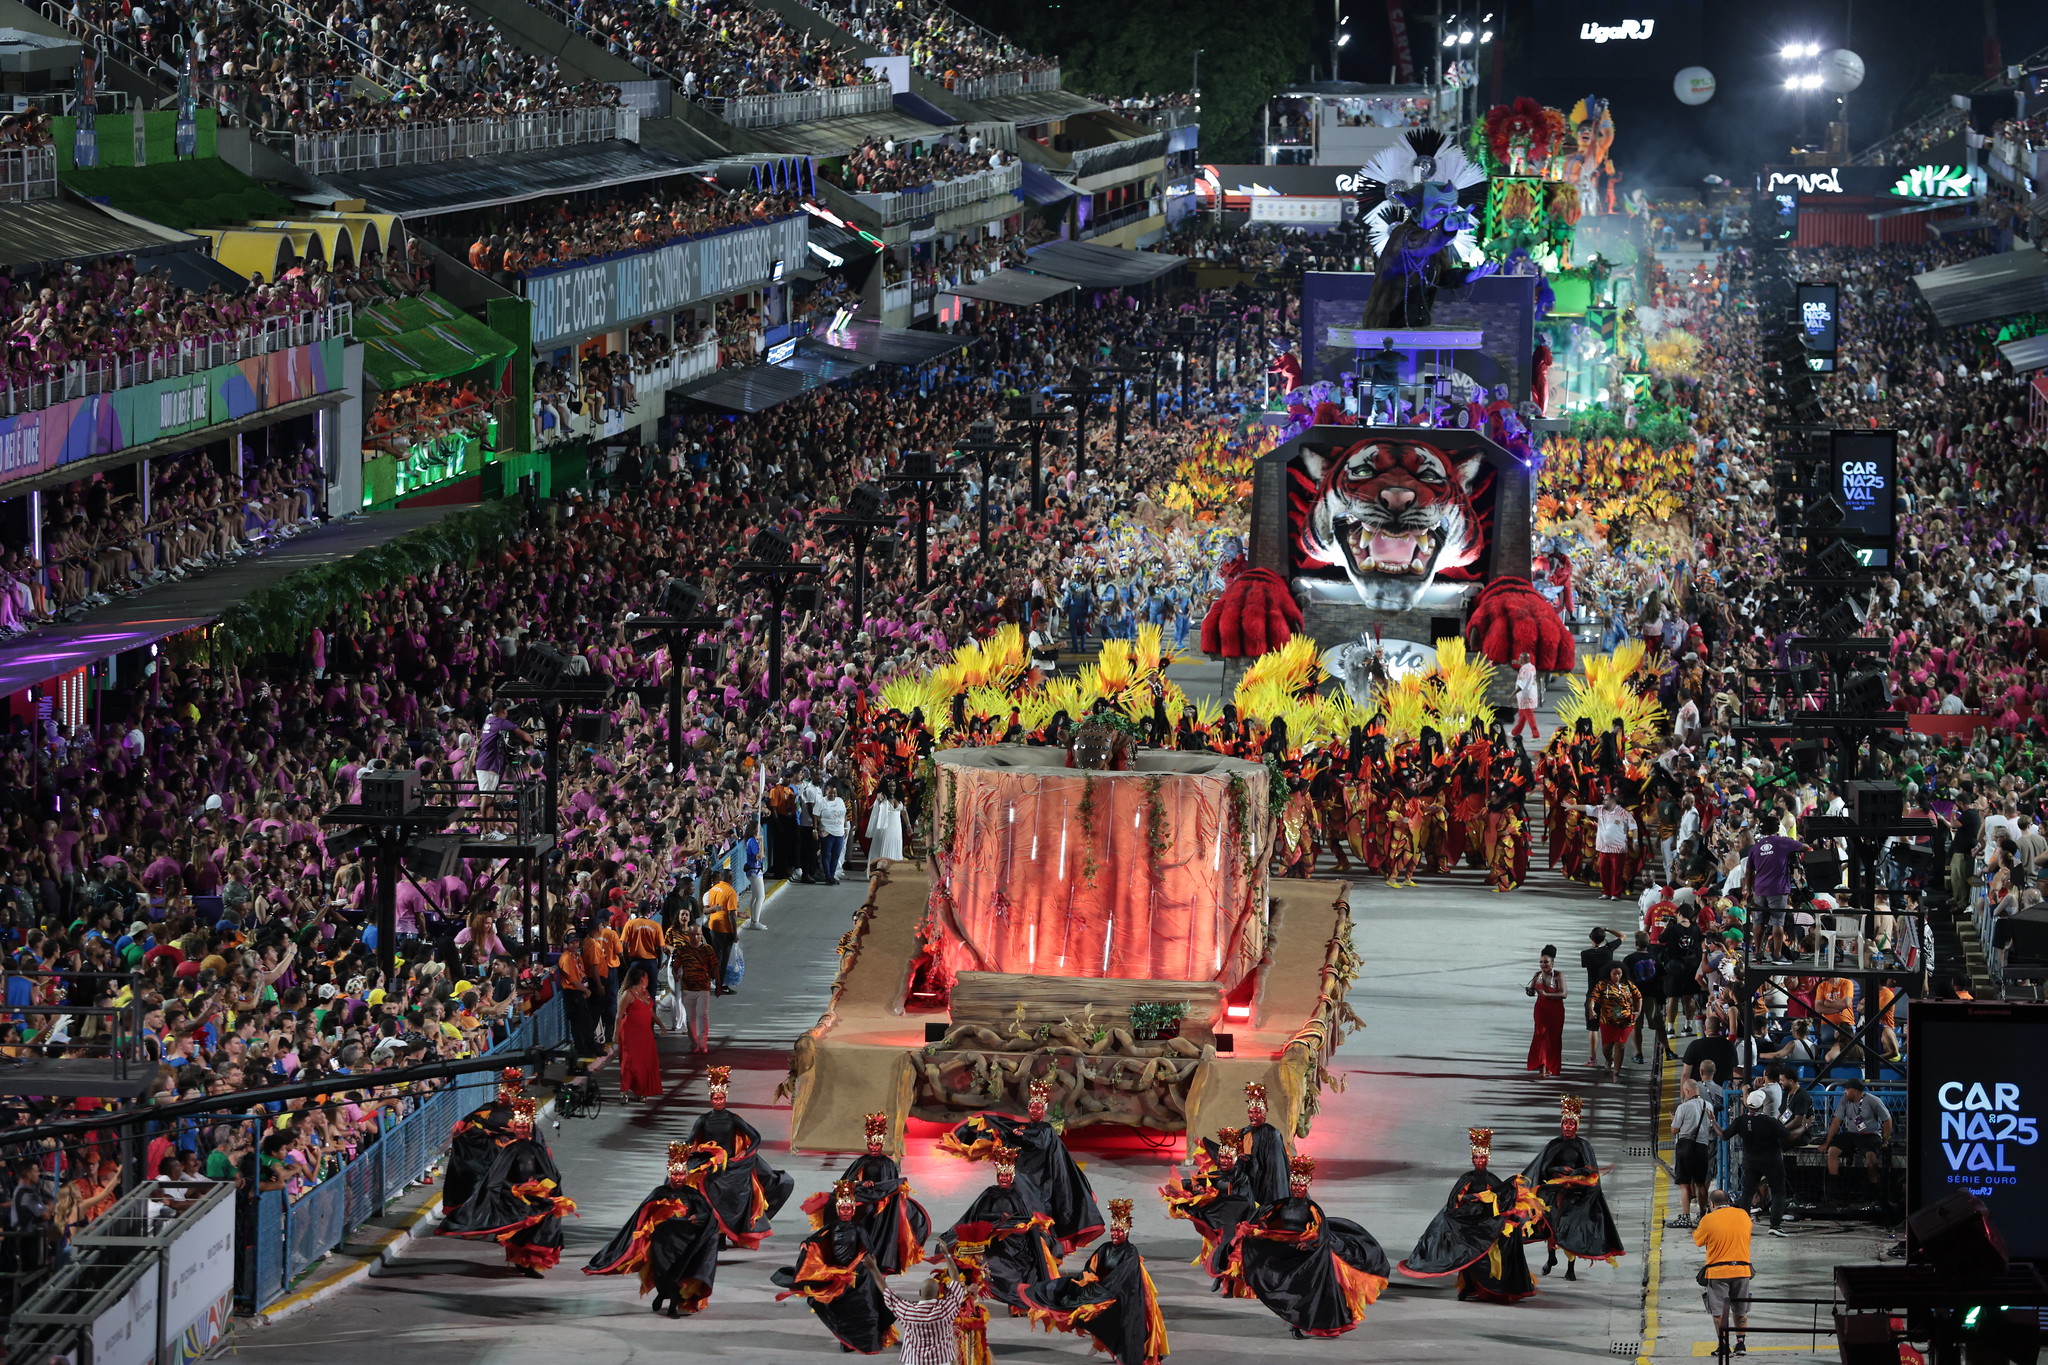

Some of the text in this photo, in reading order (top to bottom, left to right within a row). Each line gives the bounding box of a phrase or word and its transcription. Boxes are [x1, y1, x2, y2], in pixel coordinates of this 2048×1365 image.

[1580, 19, 1655, 43] LigaRJ
[528, 278, 555, 342] MAR
[556, 276, 571, 336] DE
[573, 266, 606, 332] CORES
[616, 257, 640, 321] MAR
[641, 255, 653, 314] DE
[655, 246, 690, 310] SONHOS
[700, 236, 720, 296] MAR
[721, 234, 732, 286] DE
[732, 228, 771, 285] SORRISOS
[1802, 302, 1827, 312] CAR
[5, 432, 15, 471] REI
[23, 416, 39, 465] VOCÊ
[1842, 461, 1877, 475] CAR
[1843, 487, 1875, 500] VAL
[1938, 1081, 2020, 1111] CAR
[1941, 1142, 2015, 1172] VAL
[1947, 1173, 2017, 1185] SÉRIE OURO
